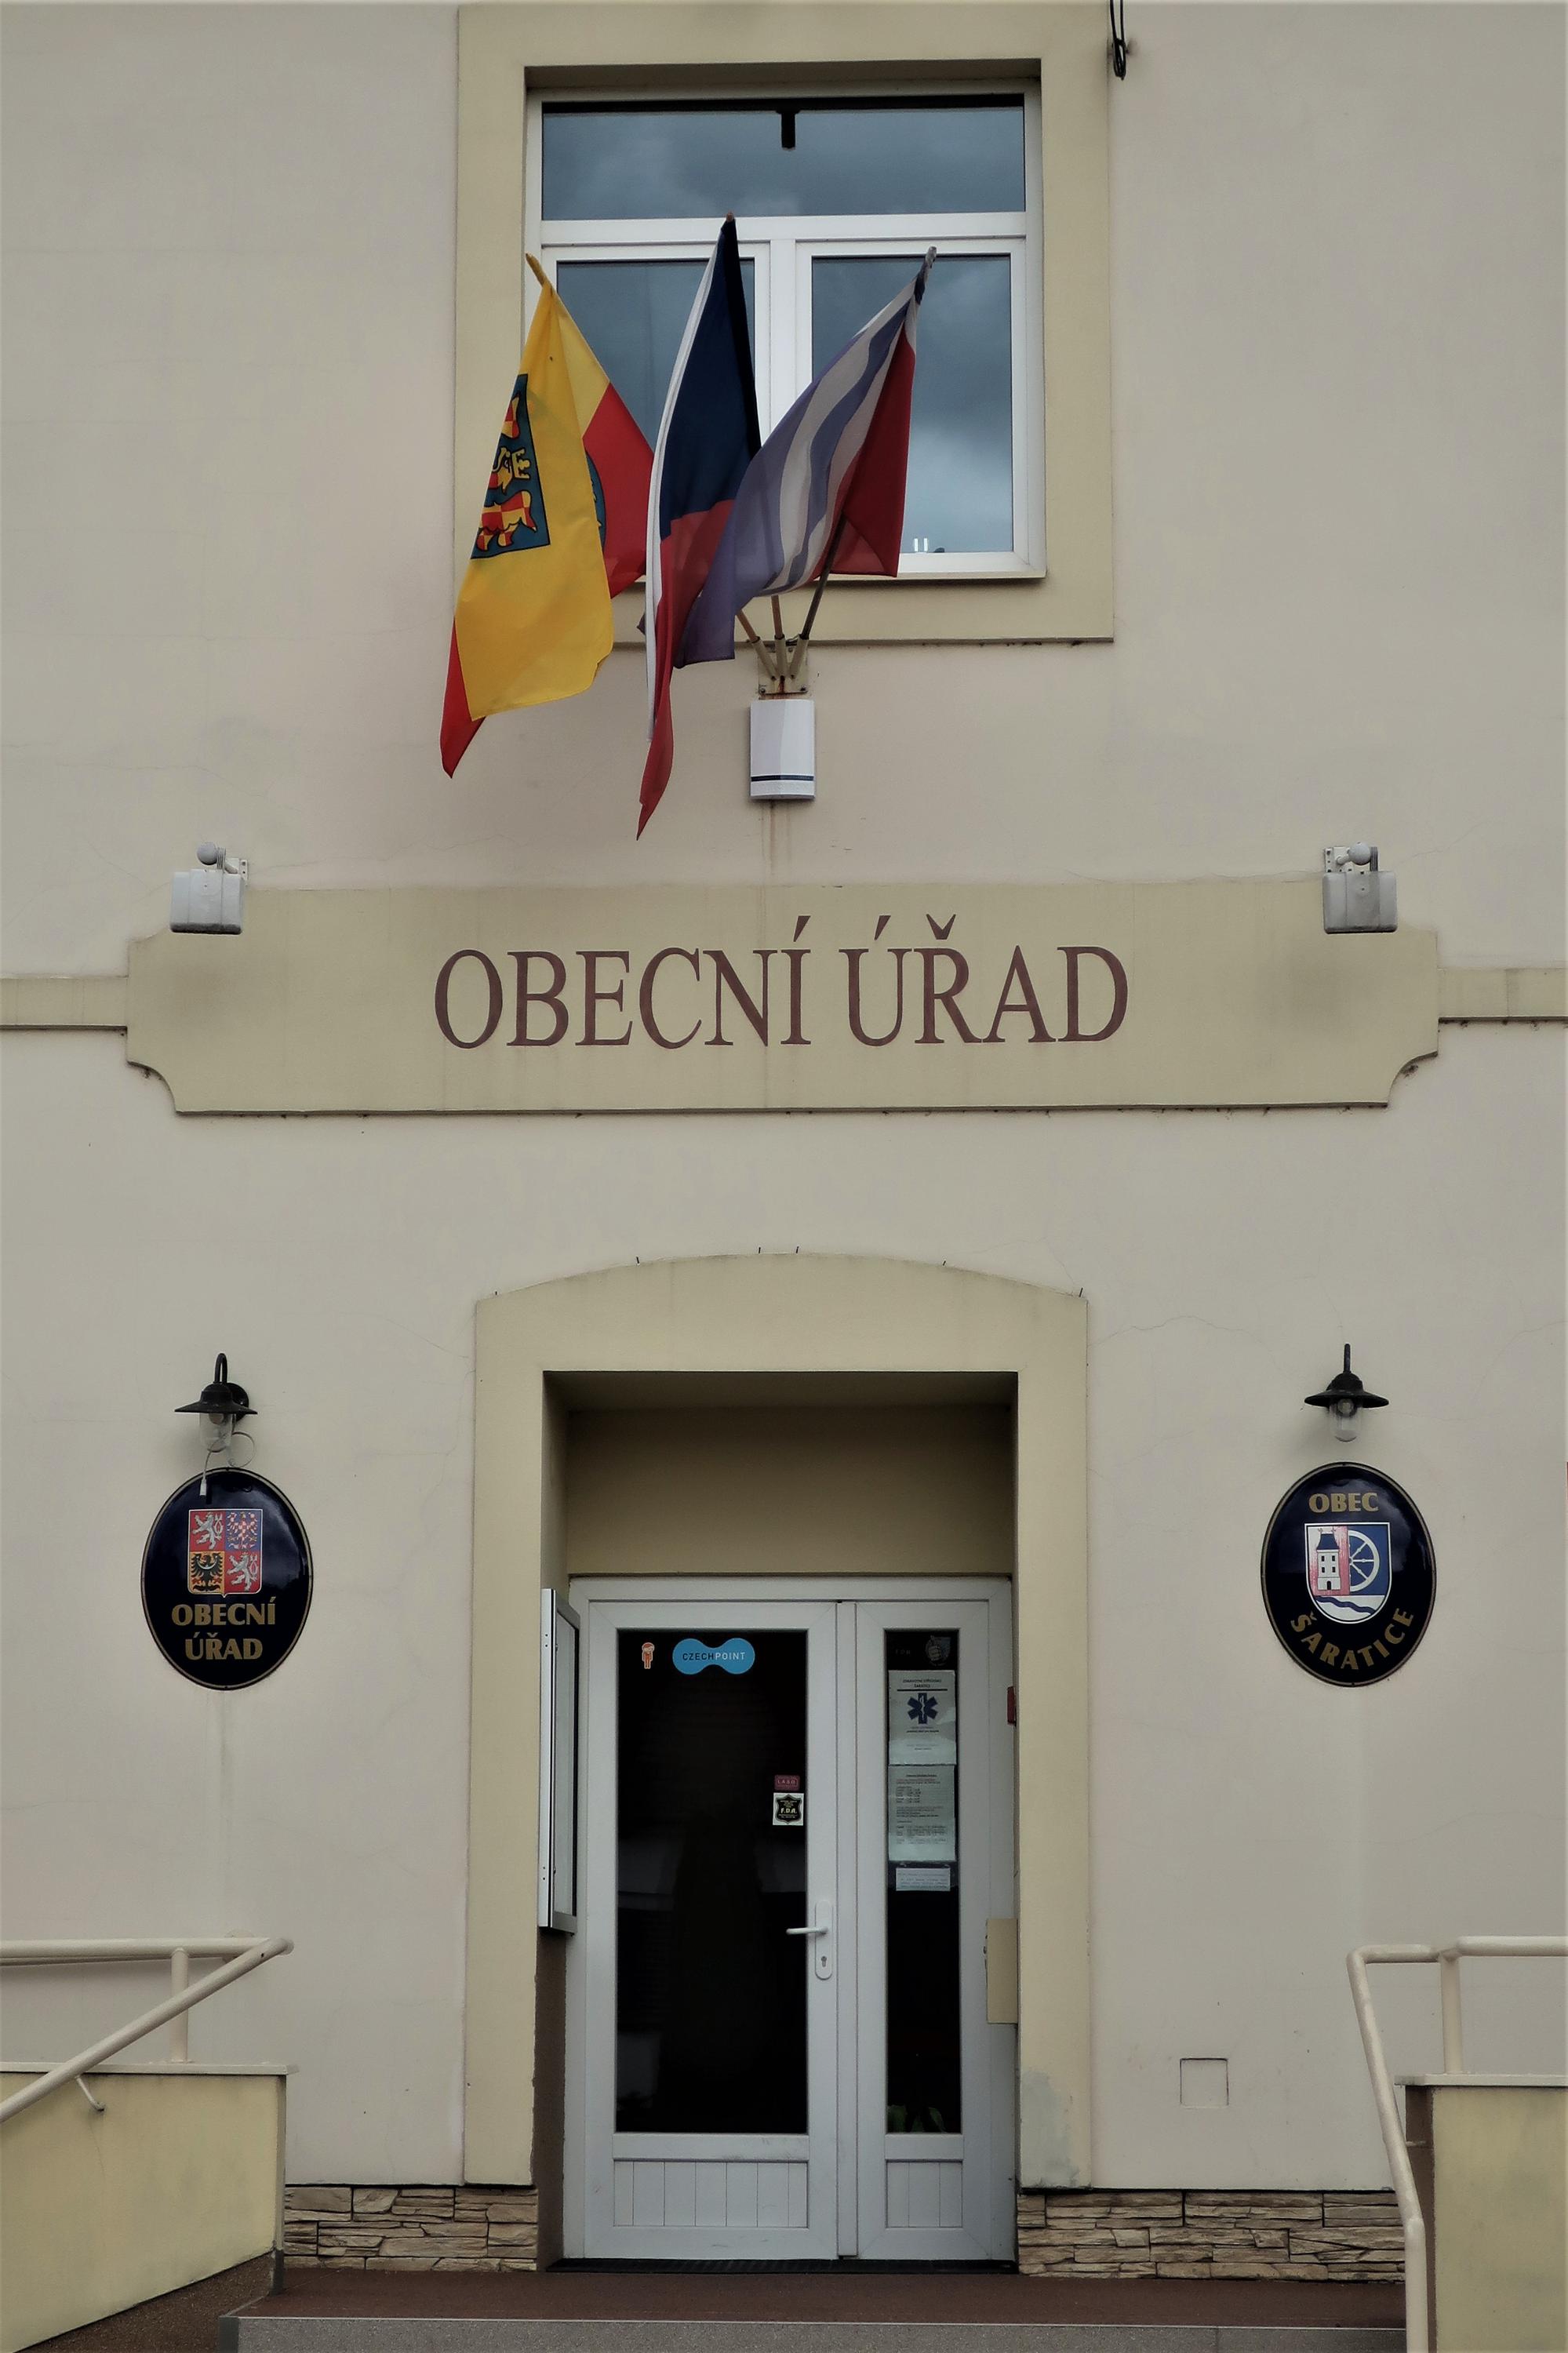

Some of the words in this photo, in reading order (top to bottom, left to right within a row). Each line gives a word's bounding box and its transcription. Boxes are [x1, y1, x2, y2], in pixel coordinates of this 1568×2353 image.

[435, 915, 811, 1049] OBECNÍ
[839, 913, 1129, 1046] ÚŘAD
[1308, 1492, 1379, 1513] OBEC
[171, 1596, 276, 1626] OBECNÍ
[184, 1631, 263, 1660] ÚŘAD
[1290, 1608, 1414, 1670] ŠARATICE
